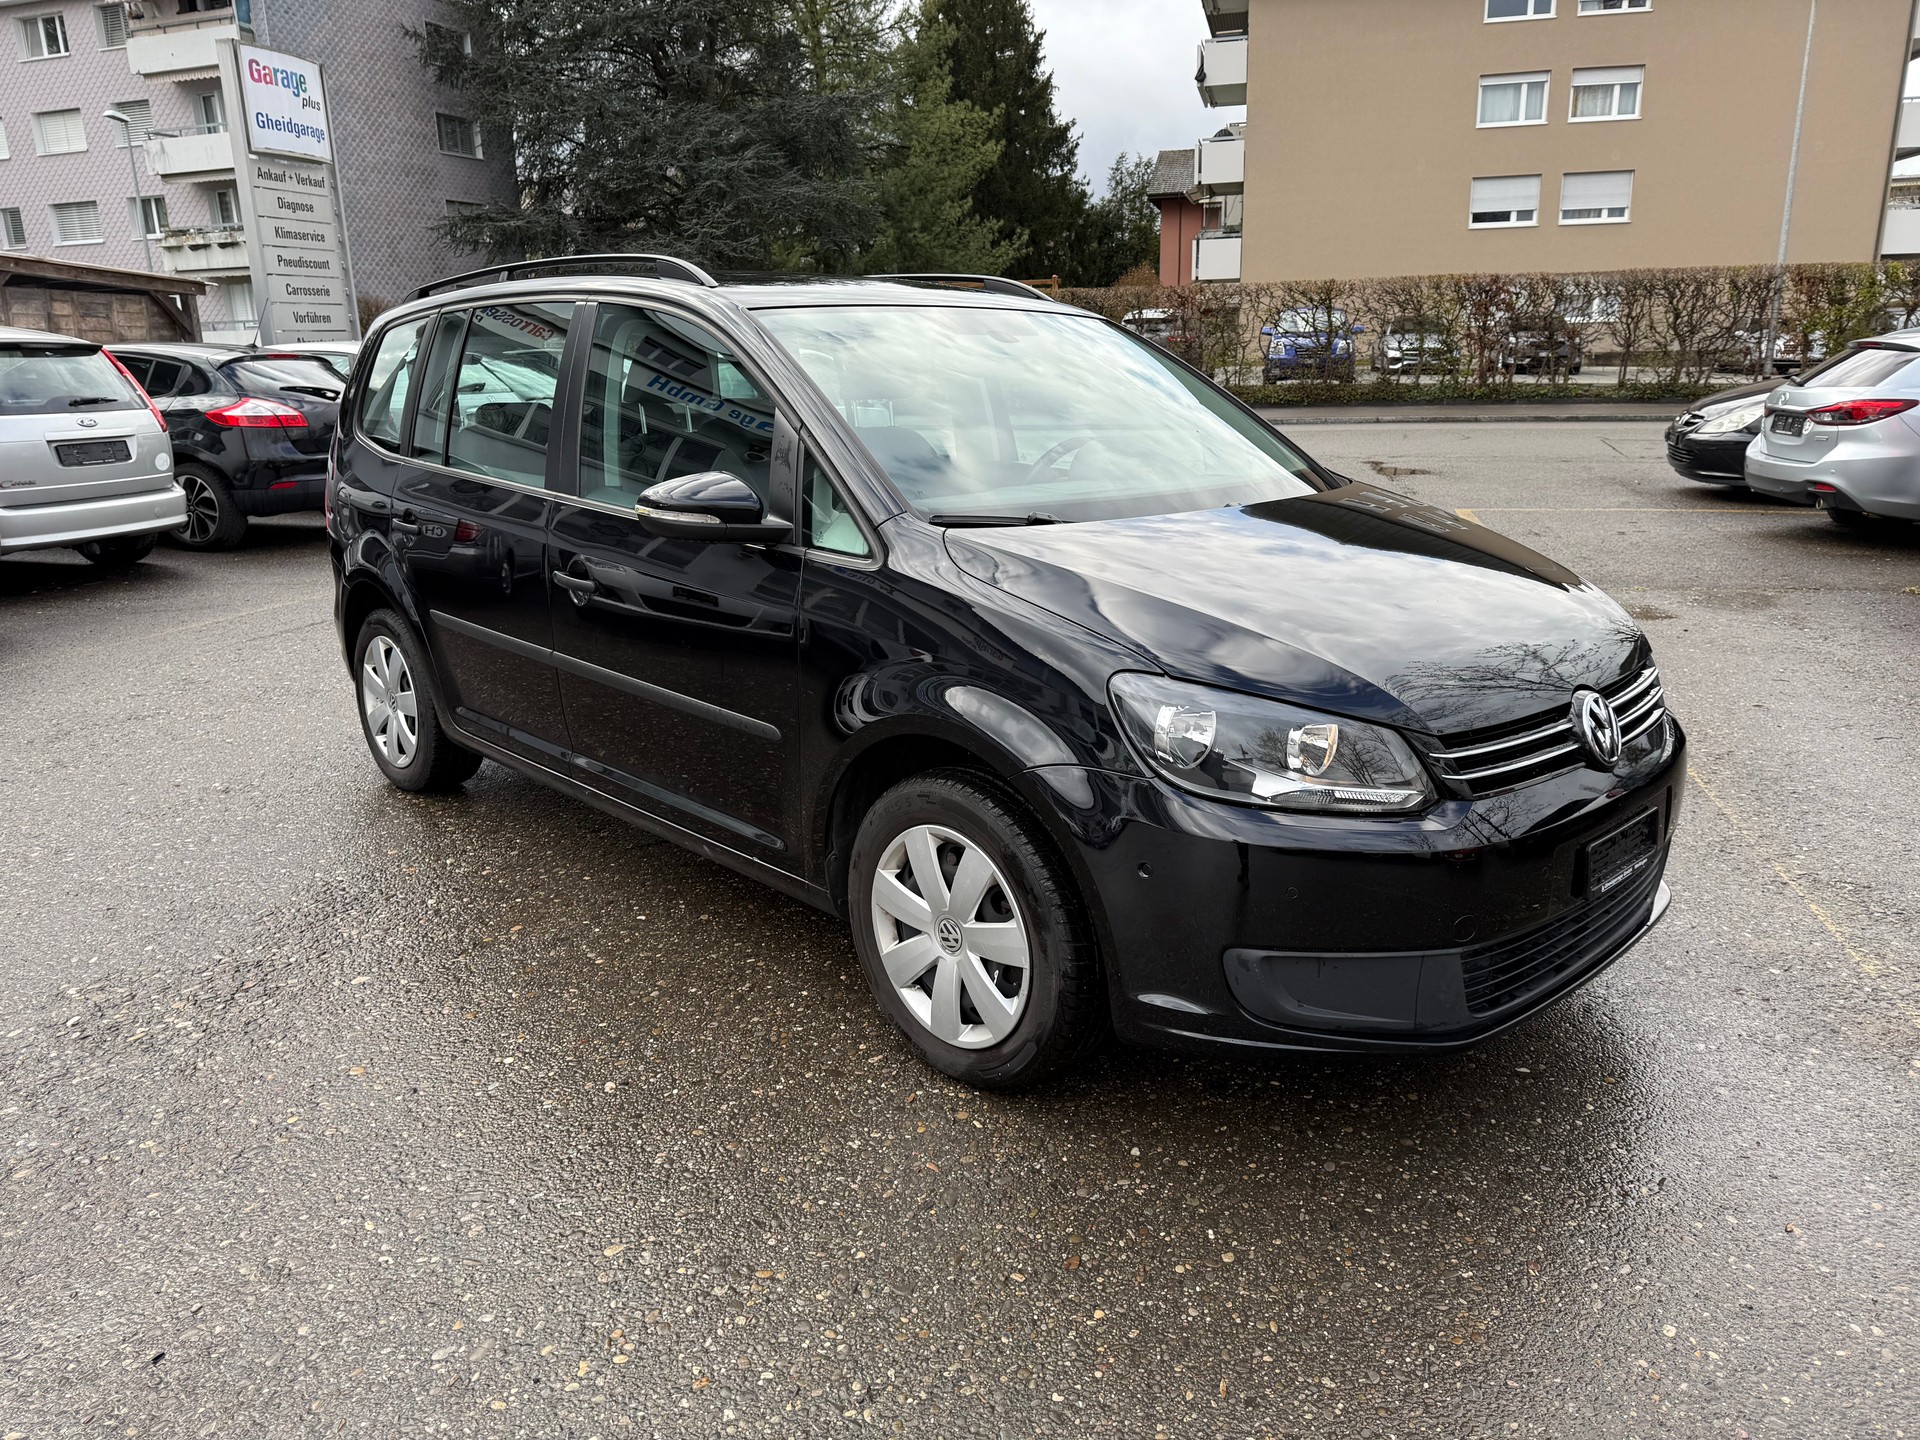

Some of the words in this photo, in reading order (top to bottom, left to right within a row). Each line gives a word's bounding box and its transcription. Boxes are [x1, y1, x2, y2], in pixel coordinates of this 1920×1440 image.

[248, 58, 307, 97] Garage
[302, 96, 321, 111] plus
[255, 112, 326, 143] Gheidgarage
[257, 166, 287, 183] Ankauf
[288, 173, 293, 181] +
[294, 172, 326, 189] Verkauf
[277, 196, 315, 213] Diagnose
[274, 226, 326, 243] Klimaservice
[277, 254, 331, 270] Pneudiscount
[285, 283, 331, 297] Carrosserie
[292, 311, 332, 324] Vorführen
